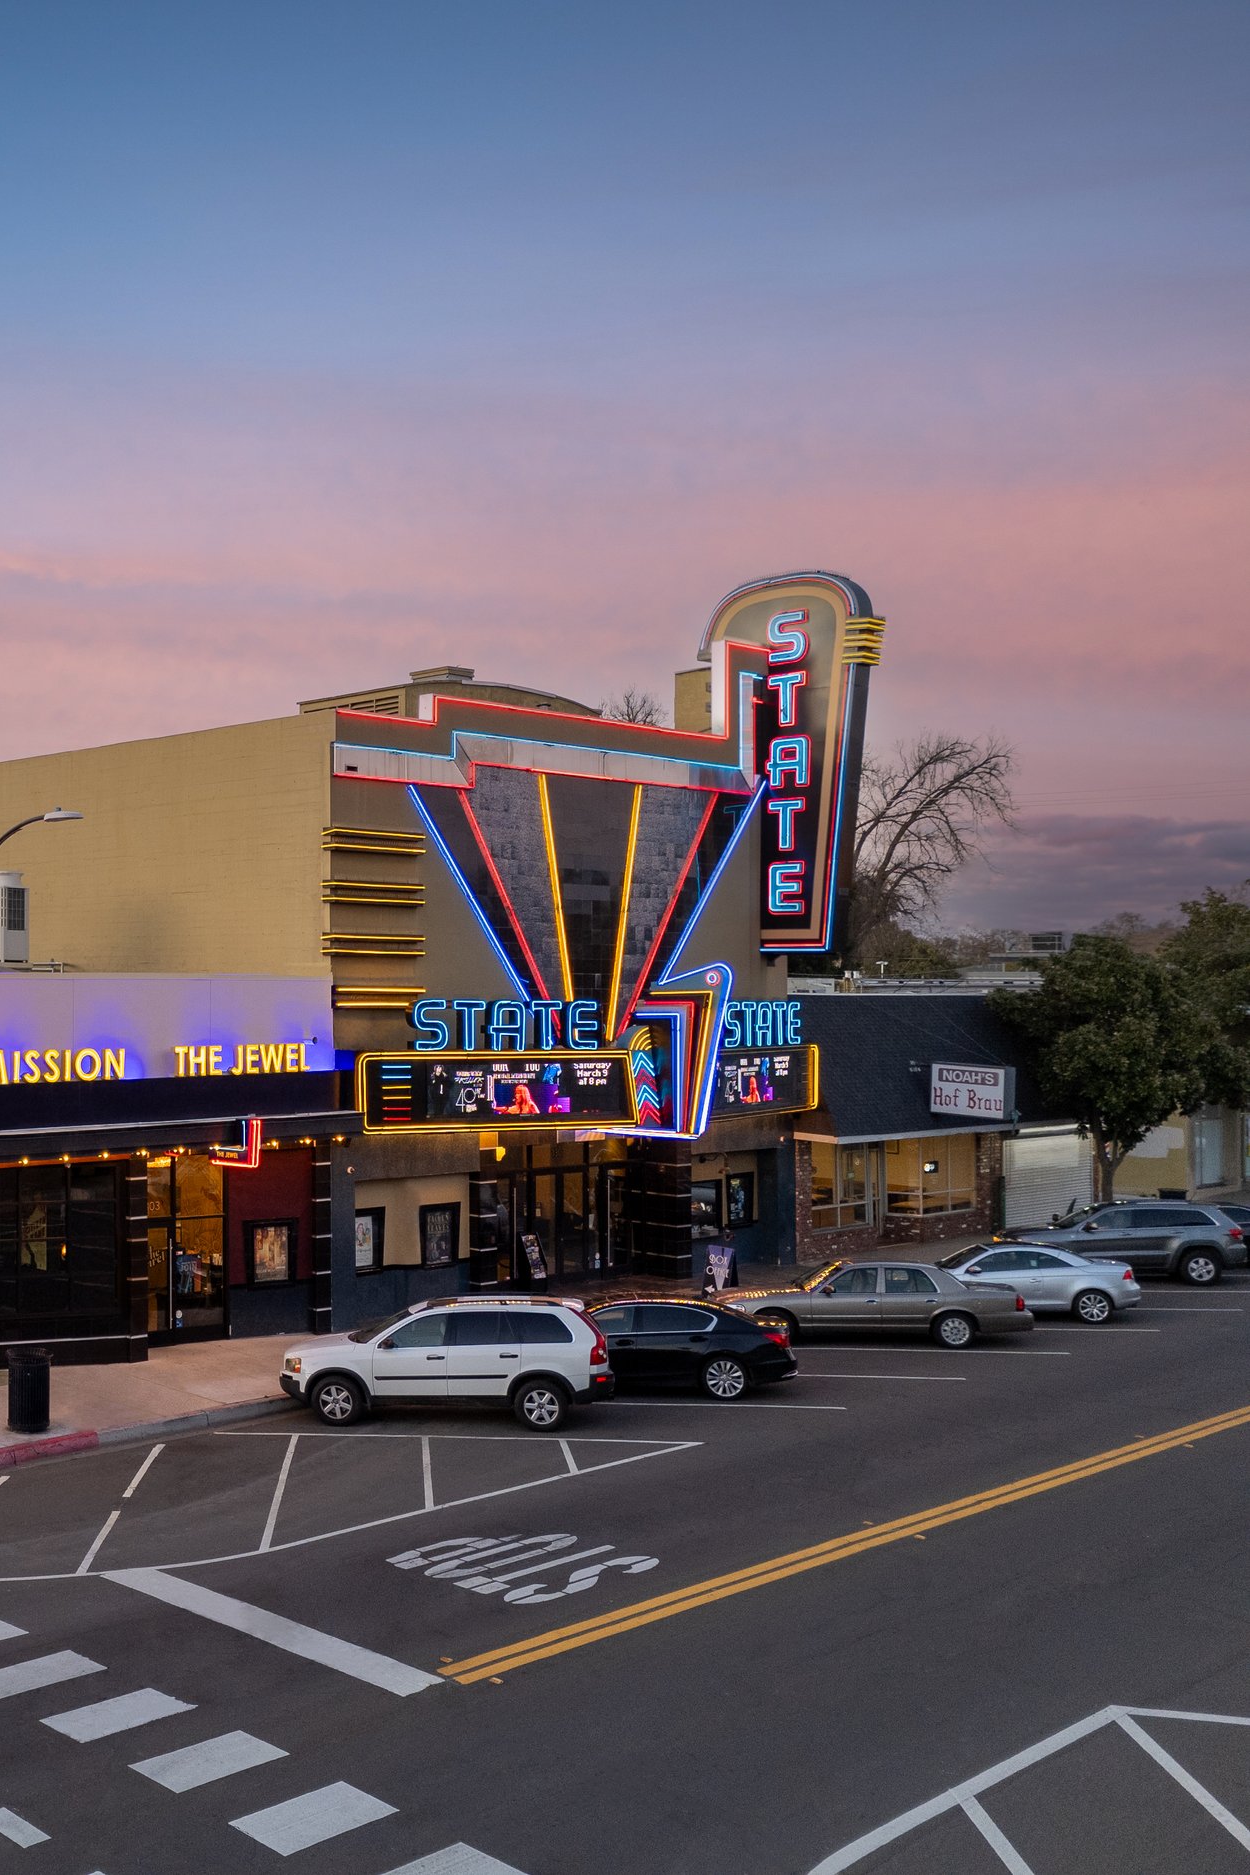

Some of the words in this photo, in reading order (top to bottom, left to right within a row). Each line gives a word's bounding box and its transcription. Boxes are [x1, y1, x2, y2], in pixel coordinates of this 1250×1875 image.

[766, 608, 812, 915] STATE
[411, 999, 599, 1052] STATE
[724, 1001, 801, 1048] STATE
[174, 1045, 223, 1078] THE
[230, 1043, 311, 1076] JEWEL
[576, 1069, 599, 1078] March
[942, 1069, 995, 1085] NOAH'S
[933, 1087, 961, 1107] Hof
[967, 1088, 1003, 1111] Brau
